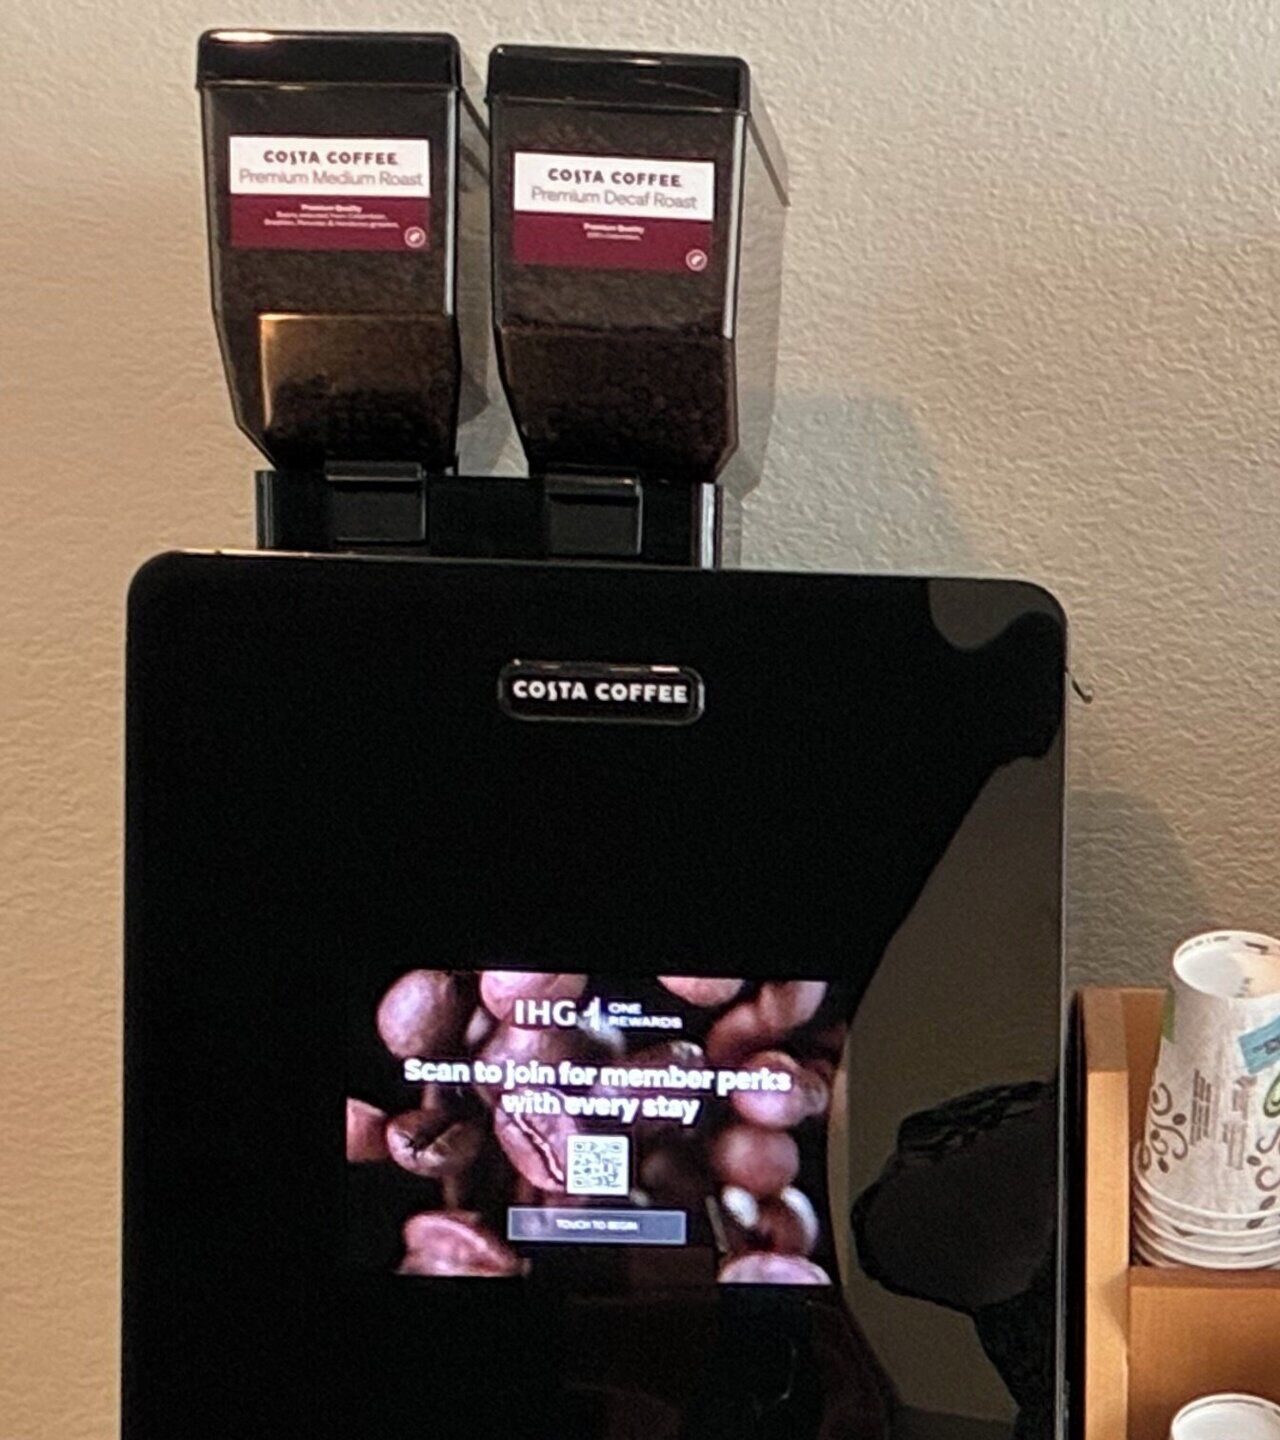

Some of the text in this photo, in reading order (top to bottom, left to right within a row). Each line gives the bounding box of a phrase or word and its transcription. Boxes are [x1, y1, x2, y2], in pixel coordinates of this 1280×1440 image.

[263, 150, 398, 165] COSTA COFFEE
[239, 168, 423, 186] Premium Medium Roast
[548, 168, 682, 187] COSTA COFFEE
[531, 186, 697, 209] Premium Decaf Roast
[513, 680, 689, 704] COSTA COFFEE
[515, 999, 577, 1027] IHG
[608, 1002, 642, 1015] ONE
[608, 1016, 683, 1029] REWARDS
[404, 1059, 792, 1095] Scan to join for member perks
[501, 1090, 700, 1124] with every stay
[592, 1220, 606, 1230] TO
